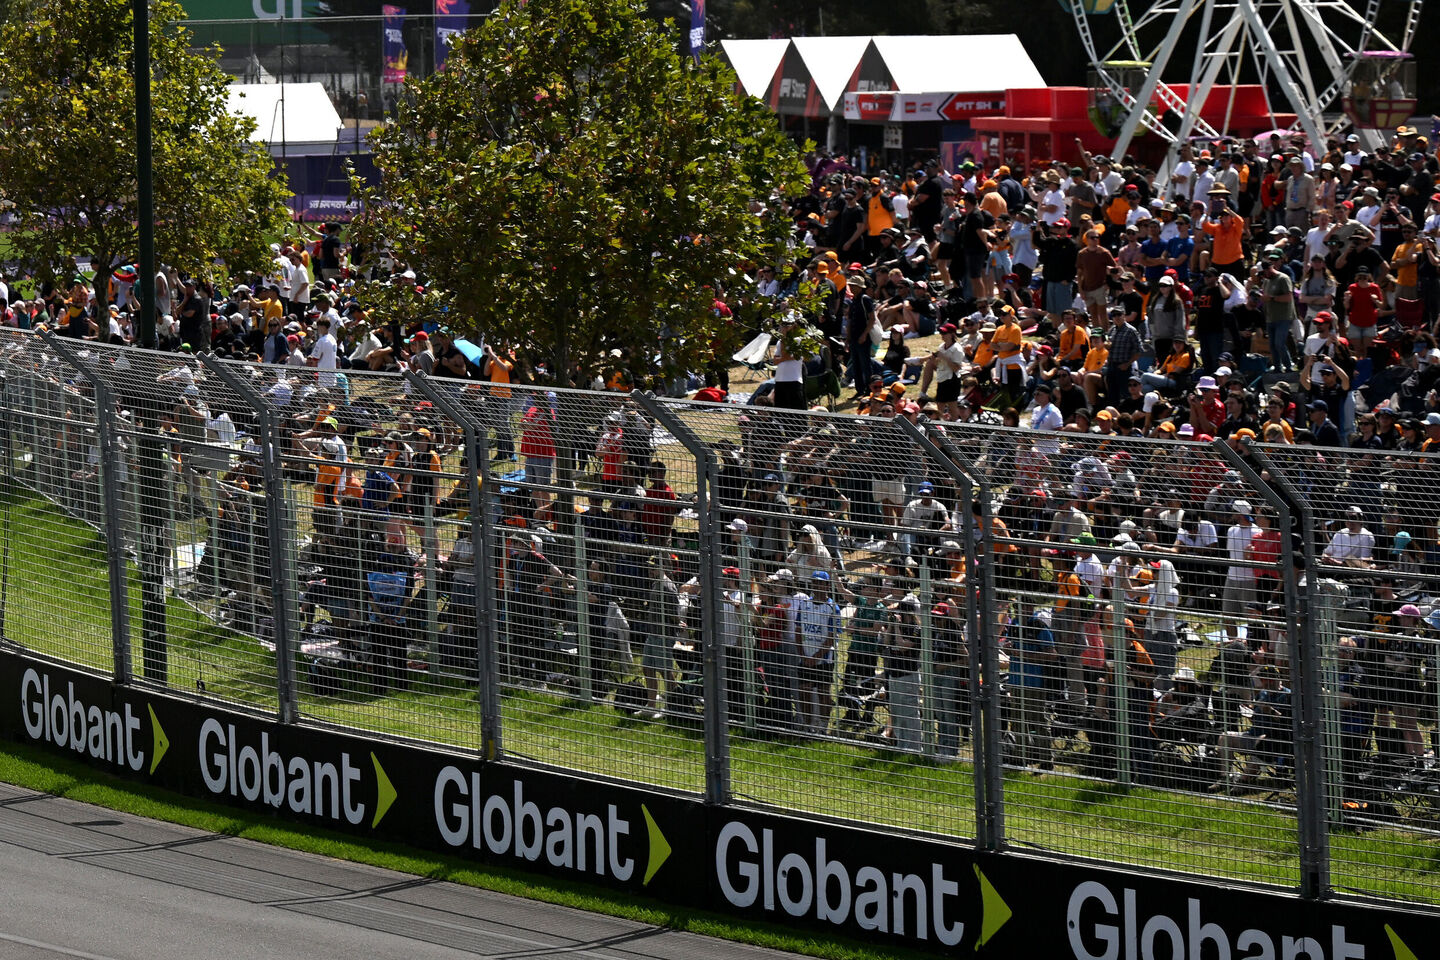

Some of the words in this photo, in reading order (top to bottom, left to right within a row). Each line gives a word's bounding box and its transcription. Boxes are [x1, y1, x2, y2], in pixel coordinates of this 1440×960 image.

[955, 101, 974, 111] PIT
[21, 668, 144, 771] Globant
[199, 717, 365, 825] Globant
[434, 765, 635, 881] Globant
[715, 821, 965, 946] Globant
